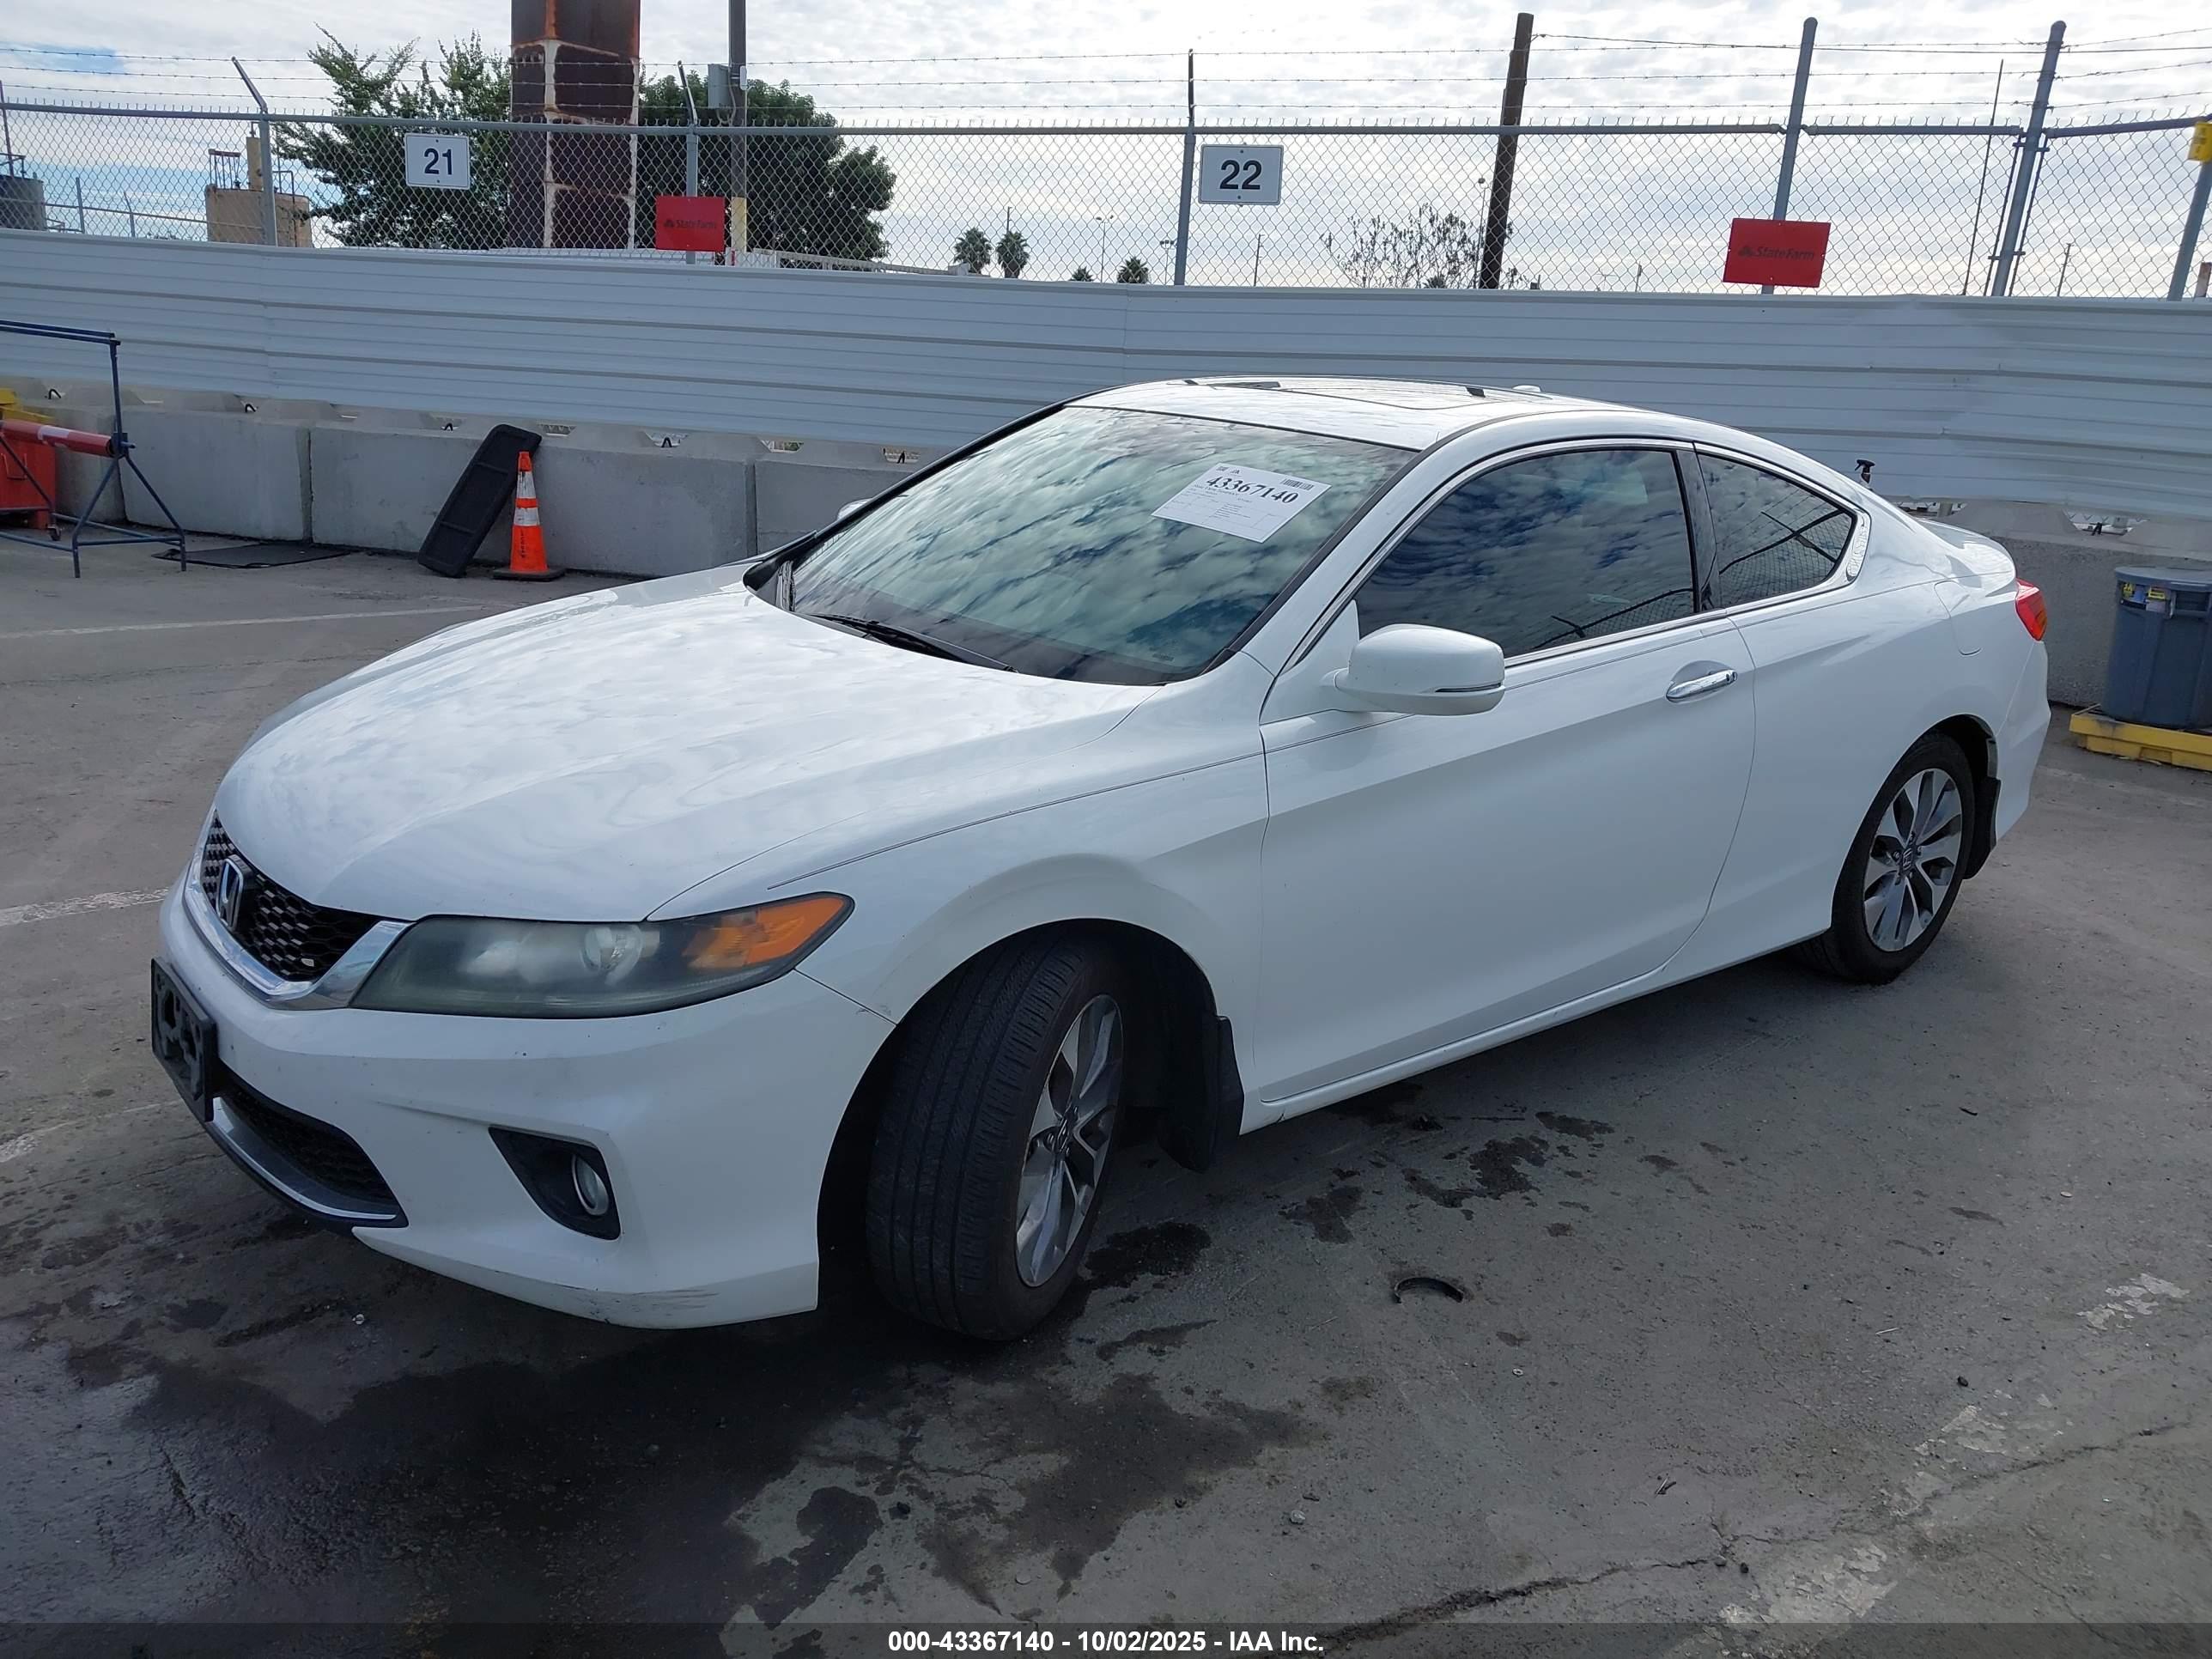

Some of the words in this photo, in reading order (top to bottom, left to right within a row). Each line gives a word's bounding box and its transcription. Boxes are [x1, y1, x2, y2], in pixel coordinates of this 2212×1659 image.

[424, 148, 453, 175] 21
[1219, 160, 1262, 190] 22
[1206, 476, 1299, 504] 43367140
